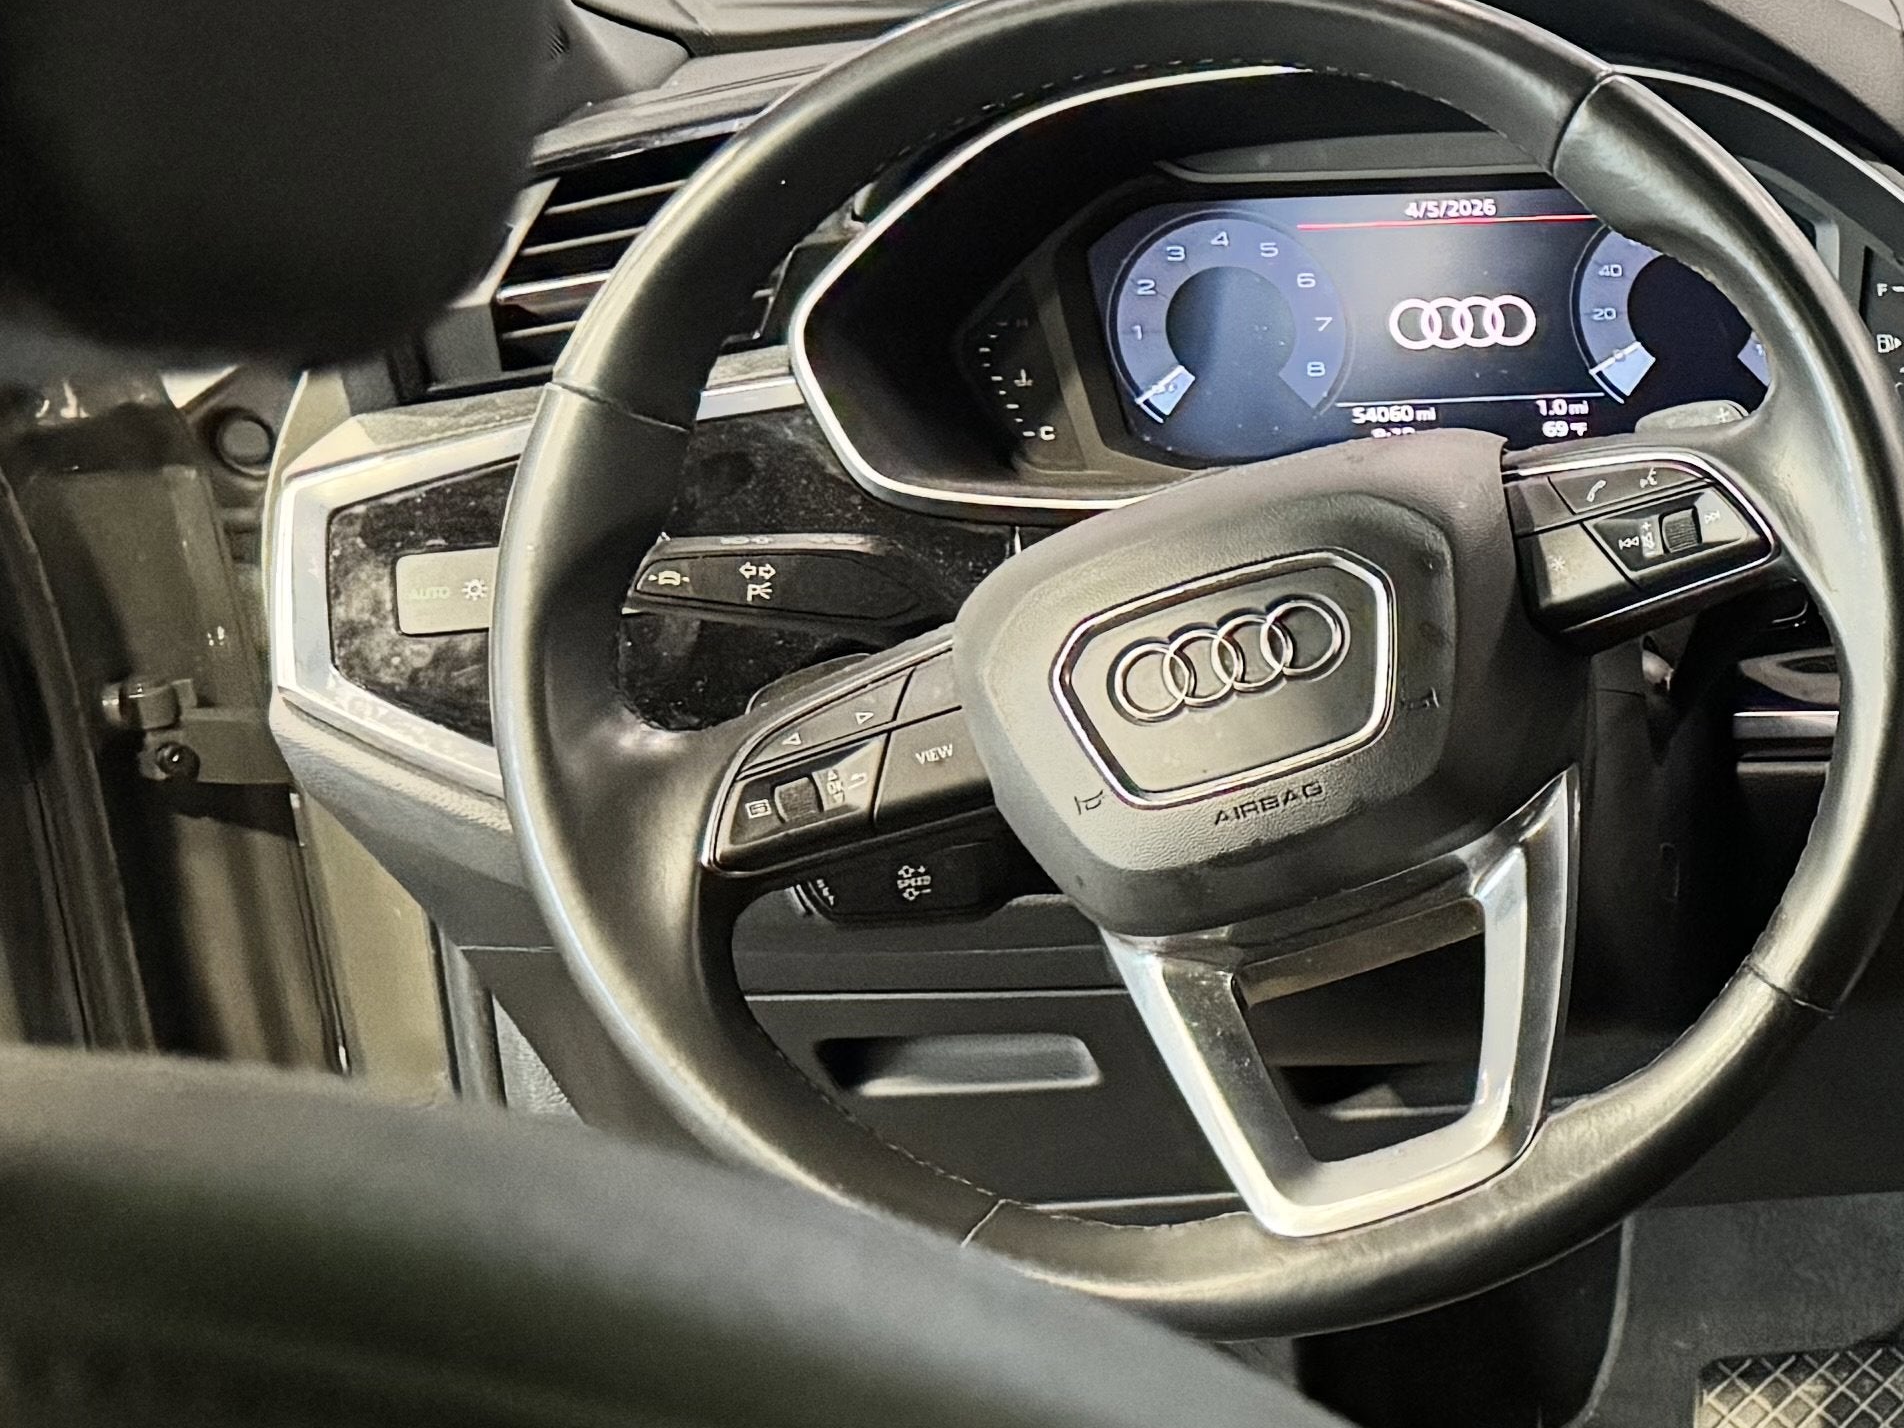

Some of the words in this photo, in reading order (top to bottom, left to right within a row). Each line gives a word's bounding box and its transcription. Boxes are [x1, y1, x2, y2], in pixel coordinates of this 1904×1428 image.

[1405, 199, 1497, 219] 4/5/2026
[1210, 231, 1229, 247] 4
[1166, 246, 1186, 262] 3
[1260, 242, 1279, 258] 5
[1599, 264, 1622, 277] 40
[1137, 279, 1157, 295] 2
[1297, 273, 1316, 288] 6
[1876, 283, 1888, 297] F
[1593, 308, 1616, 321] 20
[1132, 325, 1143, 340] 1
[1315, 317, 1333, 332] 7
[1307, 362, 1326, 377] 8
[1352, 405, 1415, 424] 54060
[1535, 399, 1568, 416] 1.0
[1039, 425, 1056, 441] C
[1542, 420, 1569, 438] 69
[915, 743, 954, 765] VIEW
[1213, 780, 1323, 826] AIRBAG
